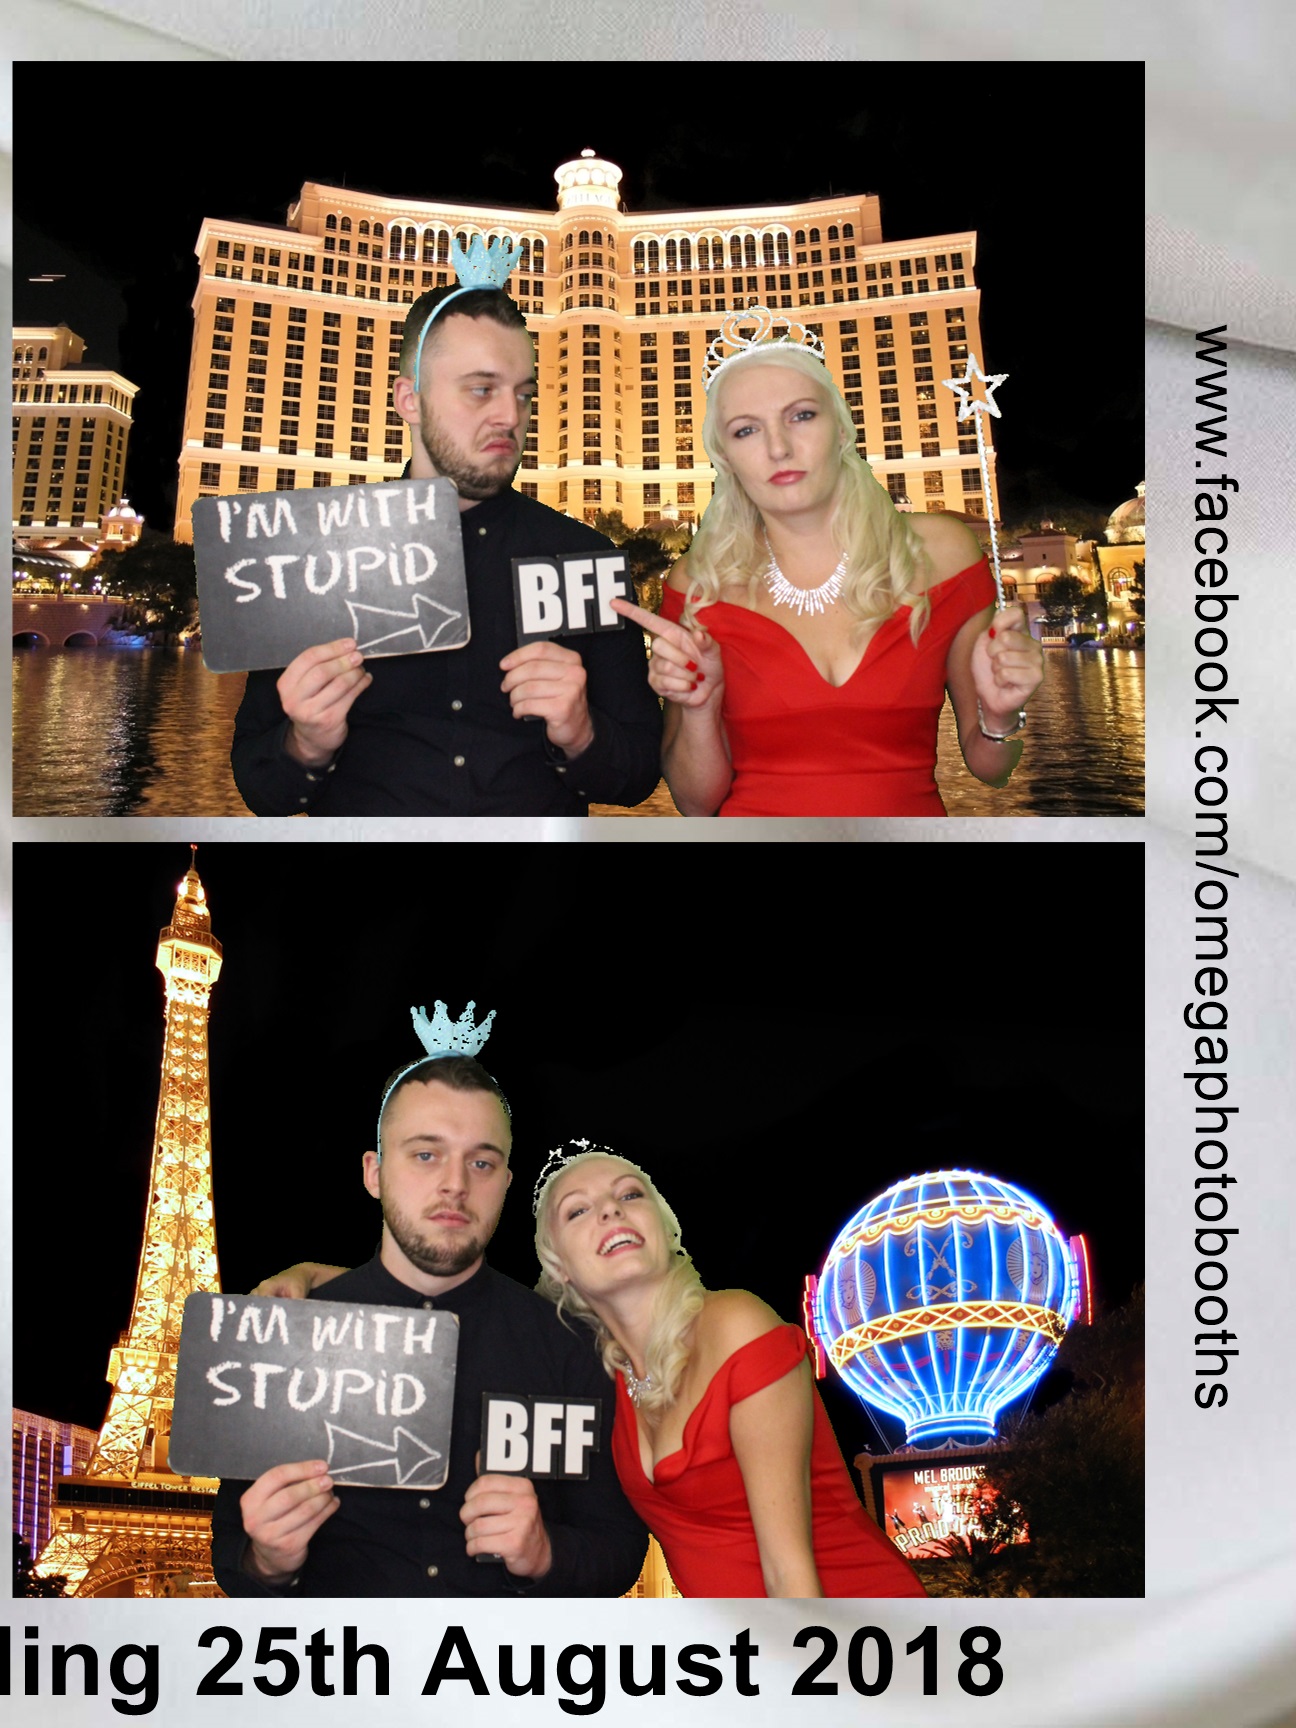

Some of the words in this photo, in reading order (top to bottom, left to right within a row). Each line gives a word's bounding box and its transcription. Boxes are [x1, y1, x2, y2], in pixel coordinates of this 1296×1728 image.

[217, 498, 298, 543] I'M
[518, 556, 626, 634] BFF
[211, 1298, 289, 1345] I'M
[486, 1400, 595, 1474] BFF
[131, 1481, 159, 1490] EIFFEL
[160, 1483, 188, 1492] TOWER
[914, 1469, 937, 1485] MEL
